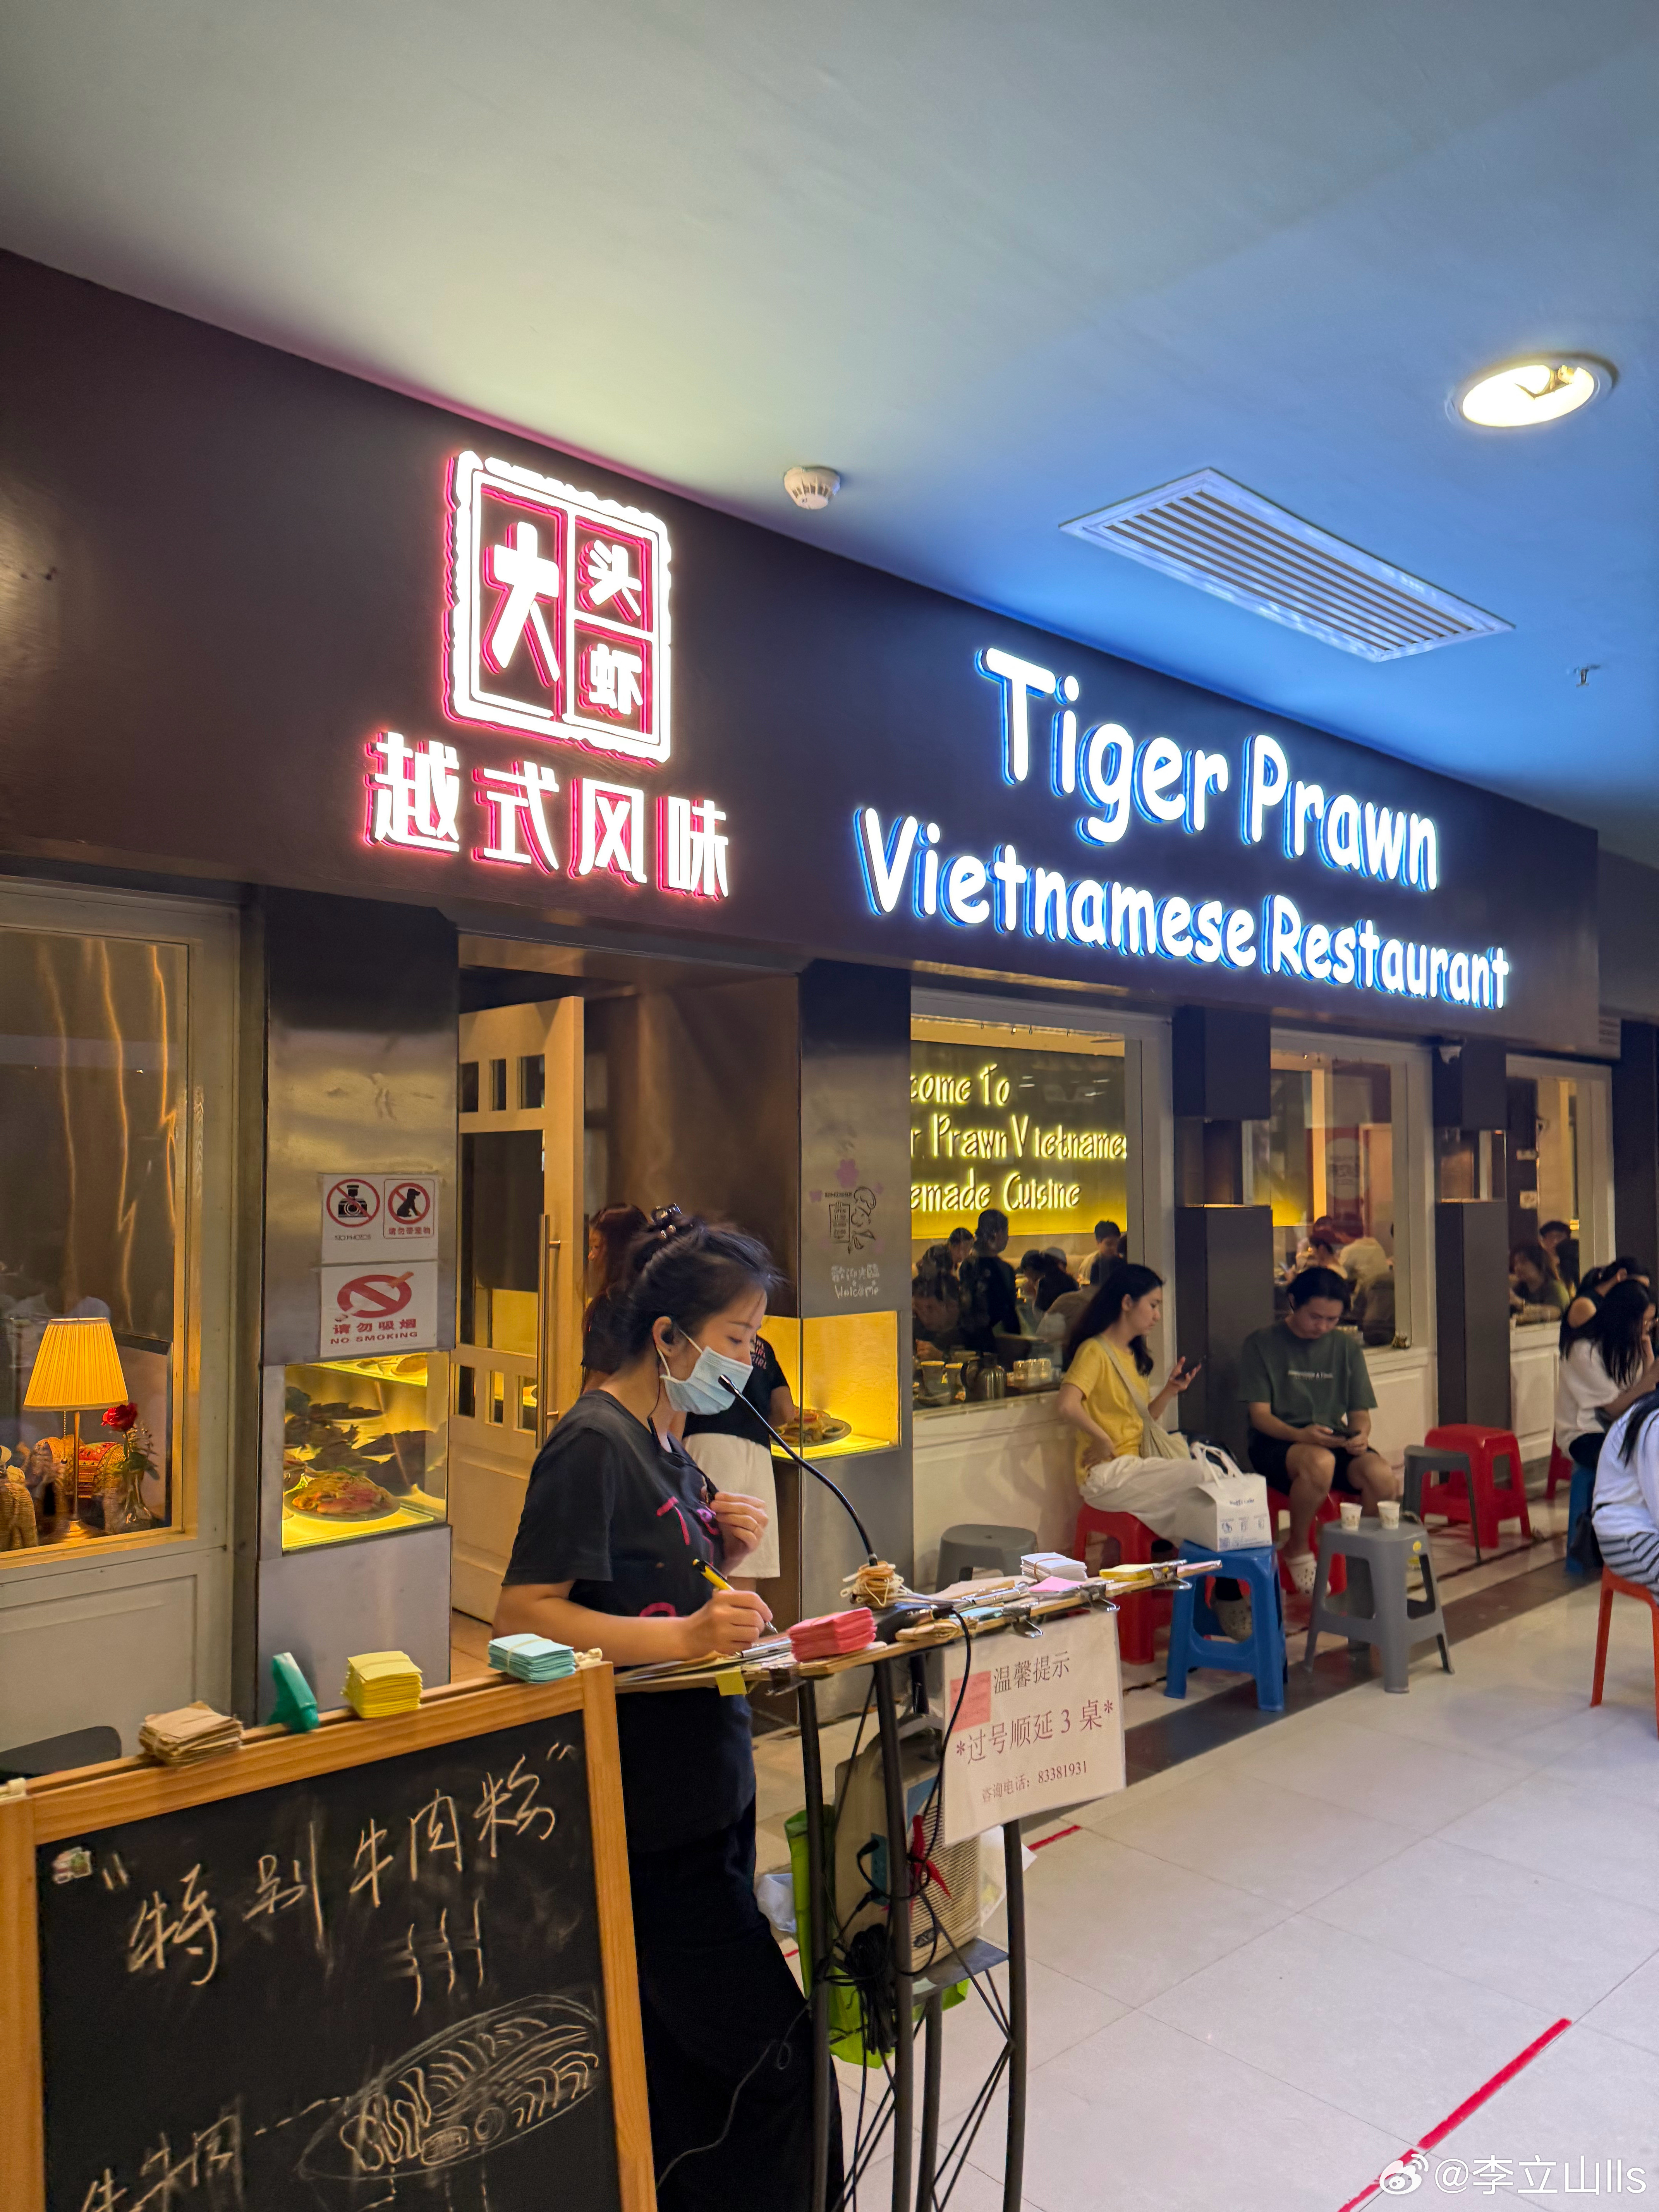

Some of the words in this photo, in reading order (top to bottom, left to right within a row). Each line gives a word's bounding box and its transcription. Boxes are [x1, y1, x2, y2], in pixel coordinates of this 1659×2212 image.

[984, 647, 1229, 843] Tiger
[1249, 734, 1437, 891] Prawn
[370, 732, 729, 898] 越式风味
[862, 807, 1256, 967] Vietnamese
[1270, 895, 1510, 1008] Restaurant
[980, 1064, 1010, 1106] To
[933, 1114, 1007, 1159] Prawn
[1003, 1172, 1080, 1212] Cuisine
[333, 1319, 416, 1334] 请勿吸烟
[356, 1332, 417, 1342] SMOKING
[994, 1651, 1070, 1694] 温馨提示
[1038, 1760, 1087, 1784] 83381931
